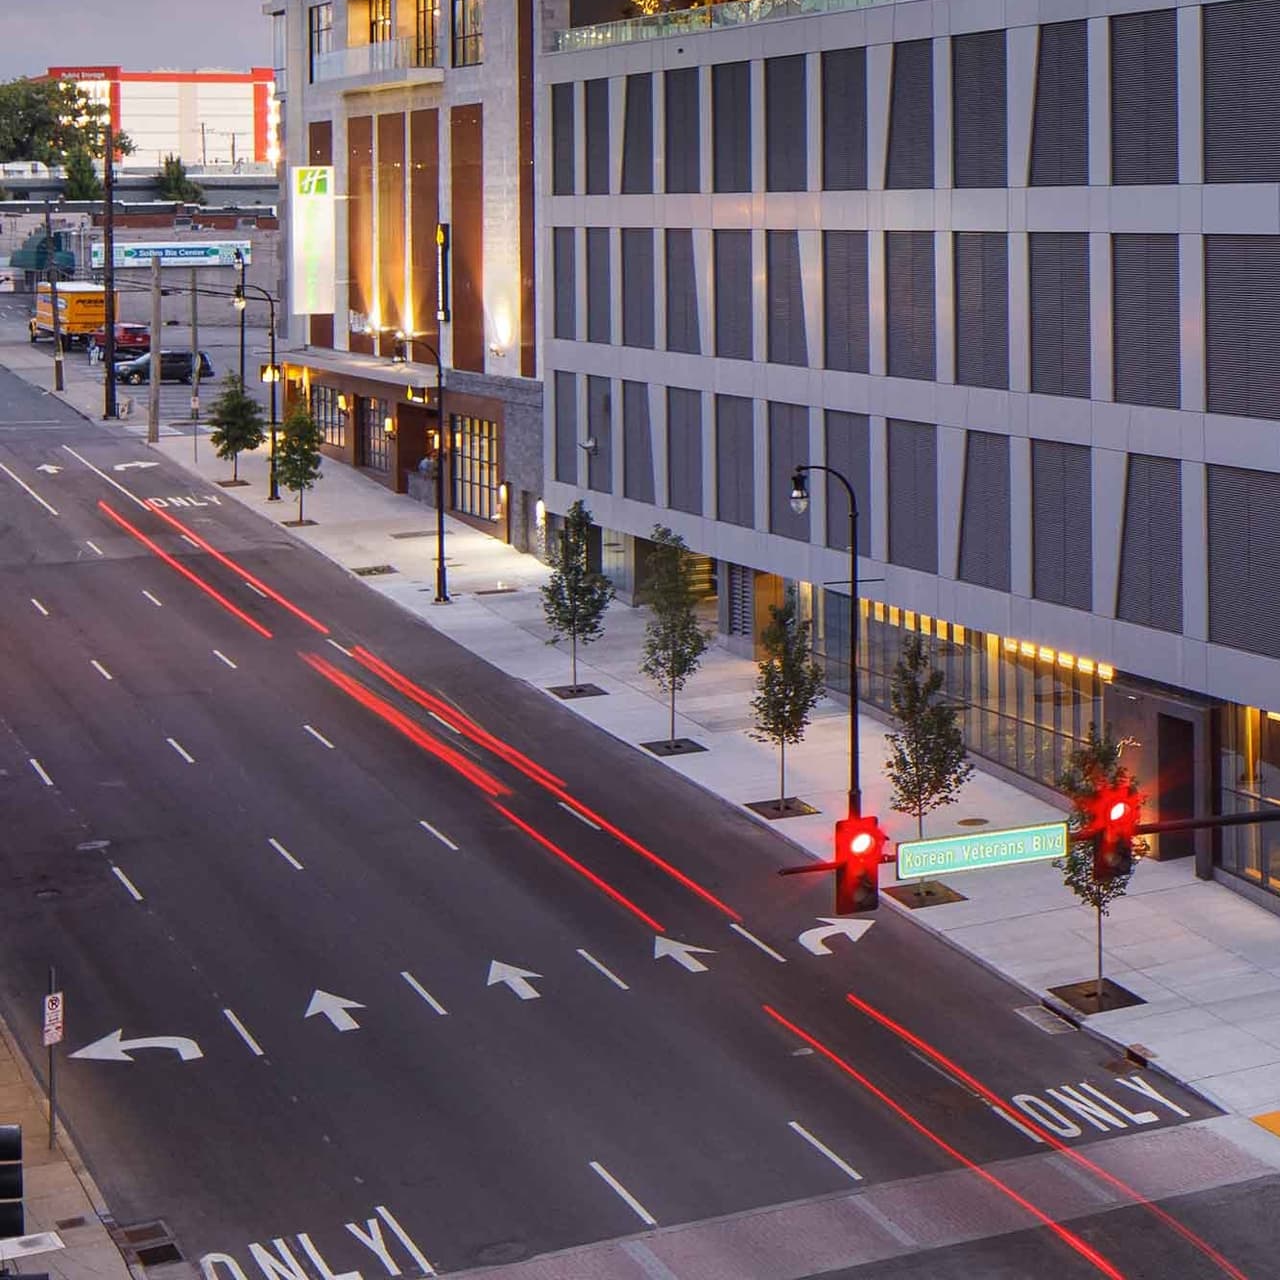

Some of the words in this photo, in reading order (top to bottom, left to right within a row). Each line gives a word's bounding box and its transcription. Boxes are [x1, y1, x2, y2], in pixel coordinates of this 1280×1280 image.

[148, 496, 222, 508] ONLY
[905, 850, 953, 869] Korean
[962, 840, 1024, 861] Veterans
[1032, 834, 1063, 852] Blvd
[1012, 1076, 1192, 1138] ONLY
